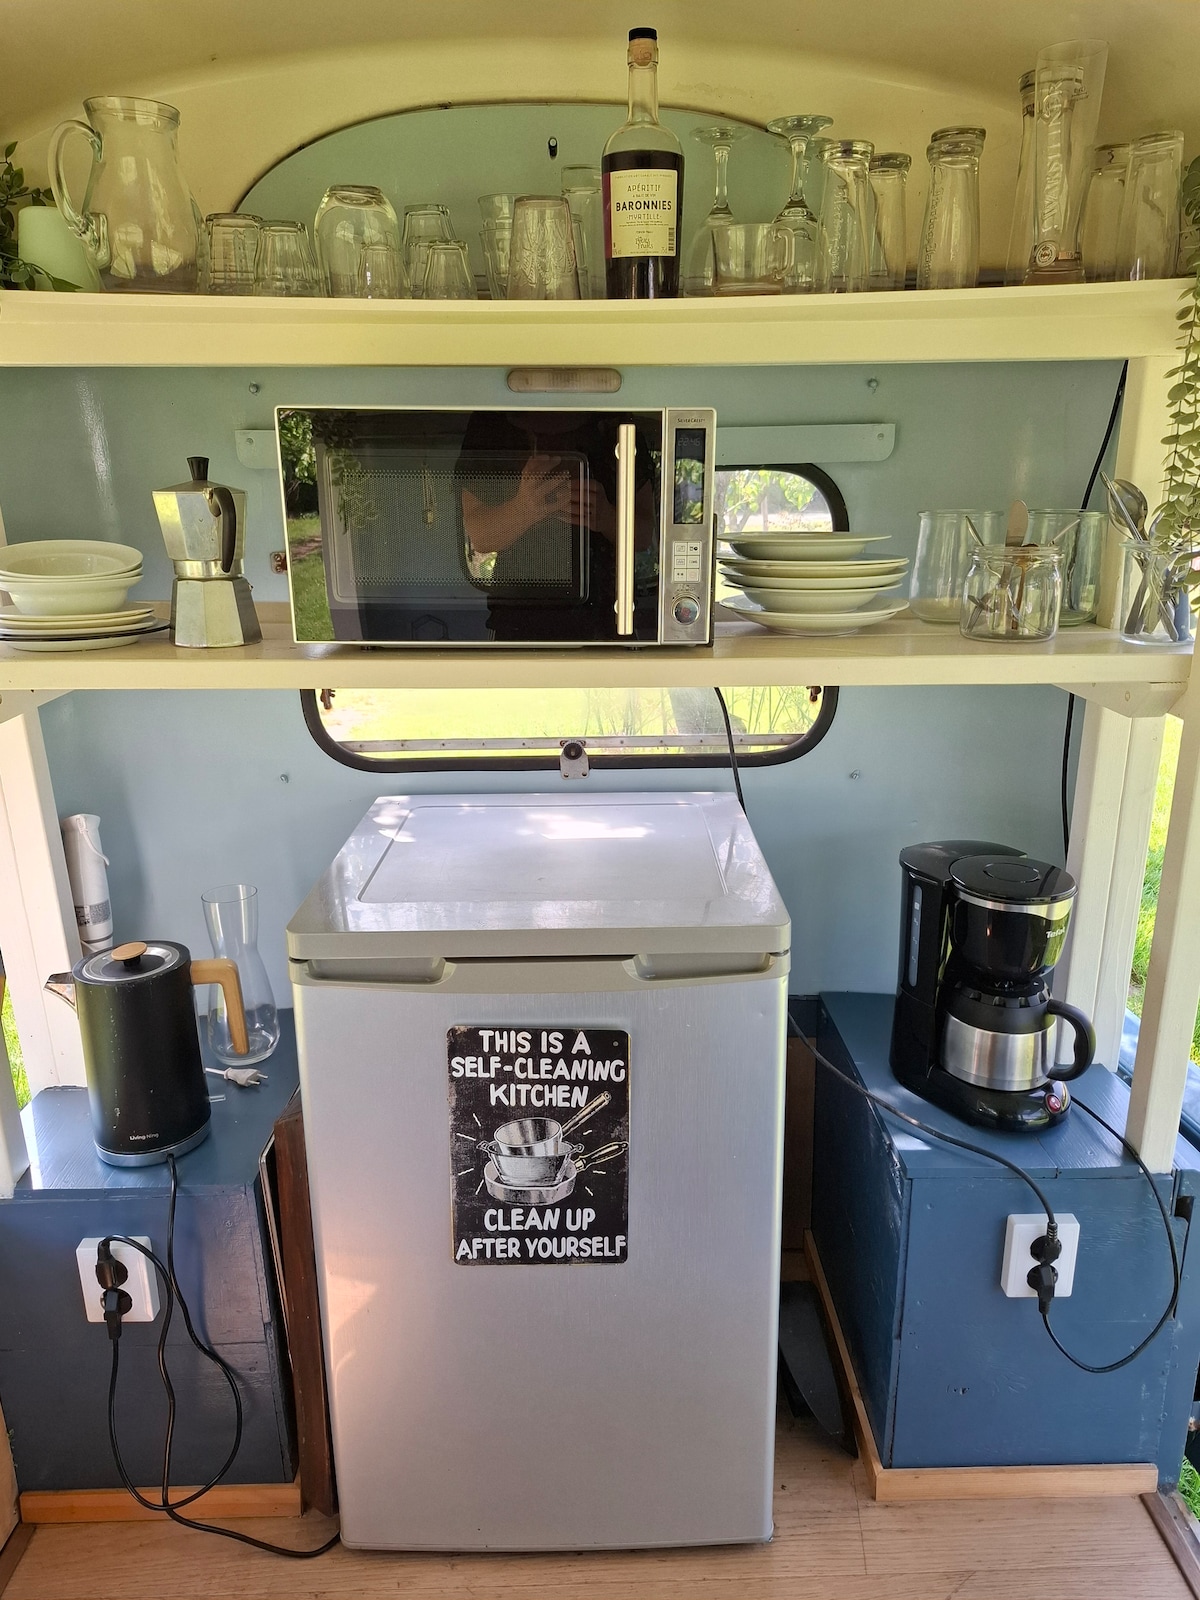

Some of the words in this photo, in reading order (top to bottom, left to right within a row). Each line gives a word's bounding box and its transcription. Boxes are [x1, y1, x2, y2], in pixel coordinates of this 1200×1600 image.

[627, 183, 661, 192] APÉRITIF
[616, 200, 672, 212] BARONNIES
[478, 1030, 532, 1054] THIS
[541, 1031, 564, 1055] IS
[571, 1031, 592, 1055] A
[451, 1056, 626, 1082] SELF-CLEANING
[489, 1083, 589, 1108] KITCHEN
[484, 1207, 560, 1231] CLEAN
[565, 1208, 596, 1231] UP
[456, 1237, 521, 1260] AFTER
[525, 1235, 627, 1259] YOURSELF
